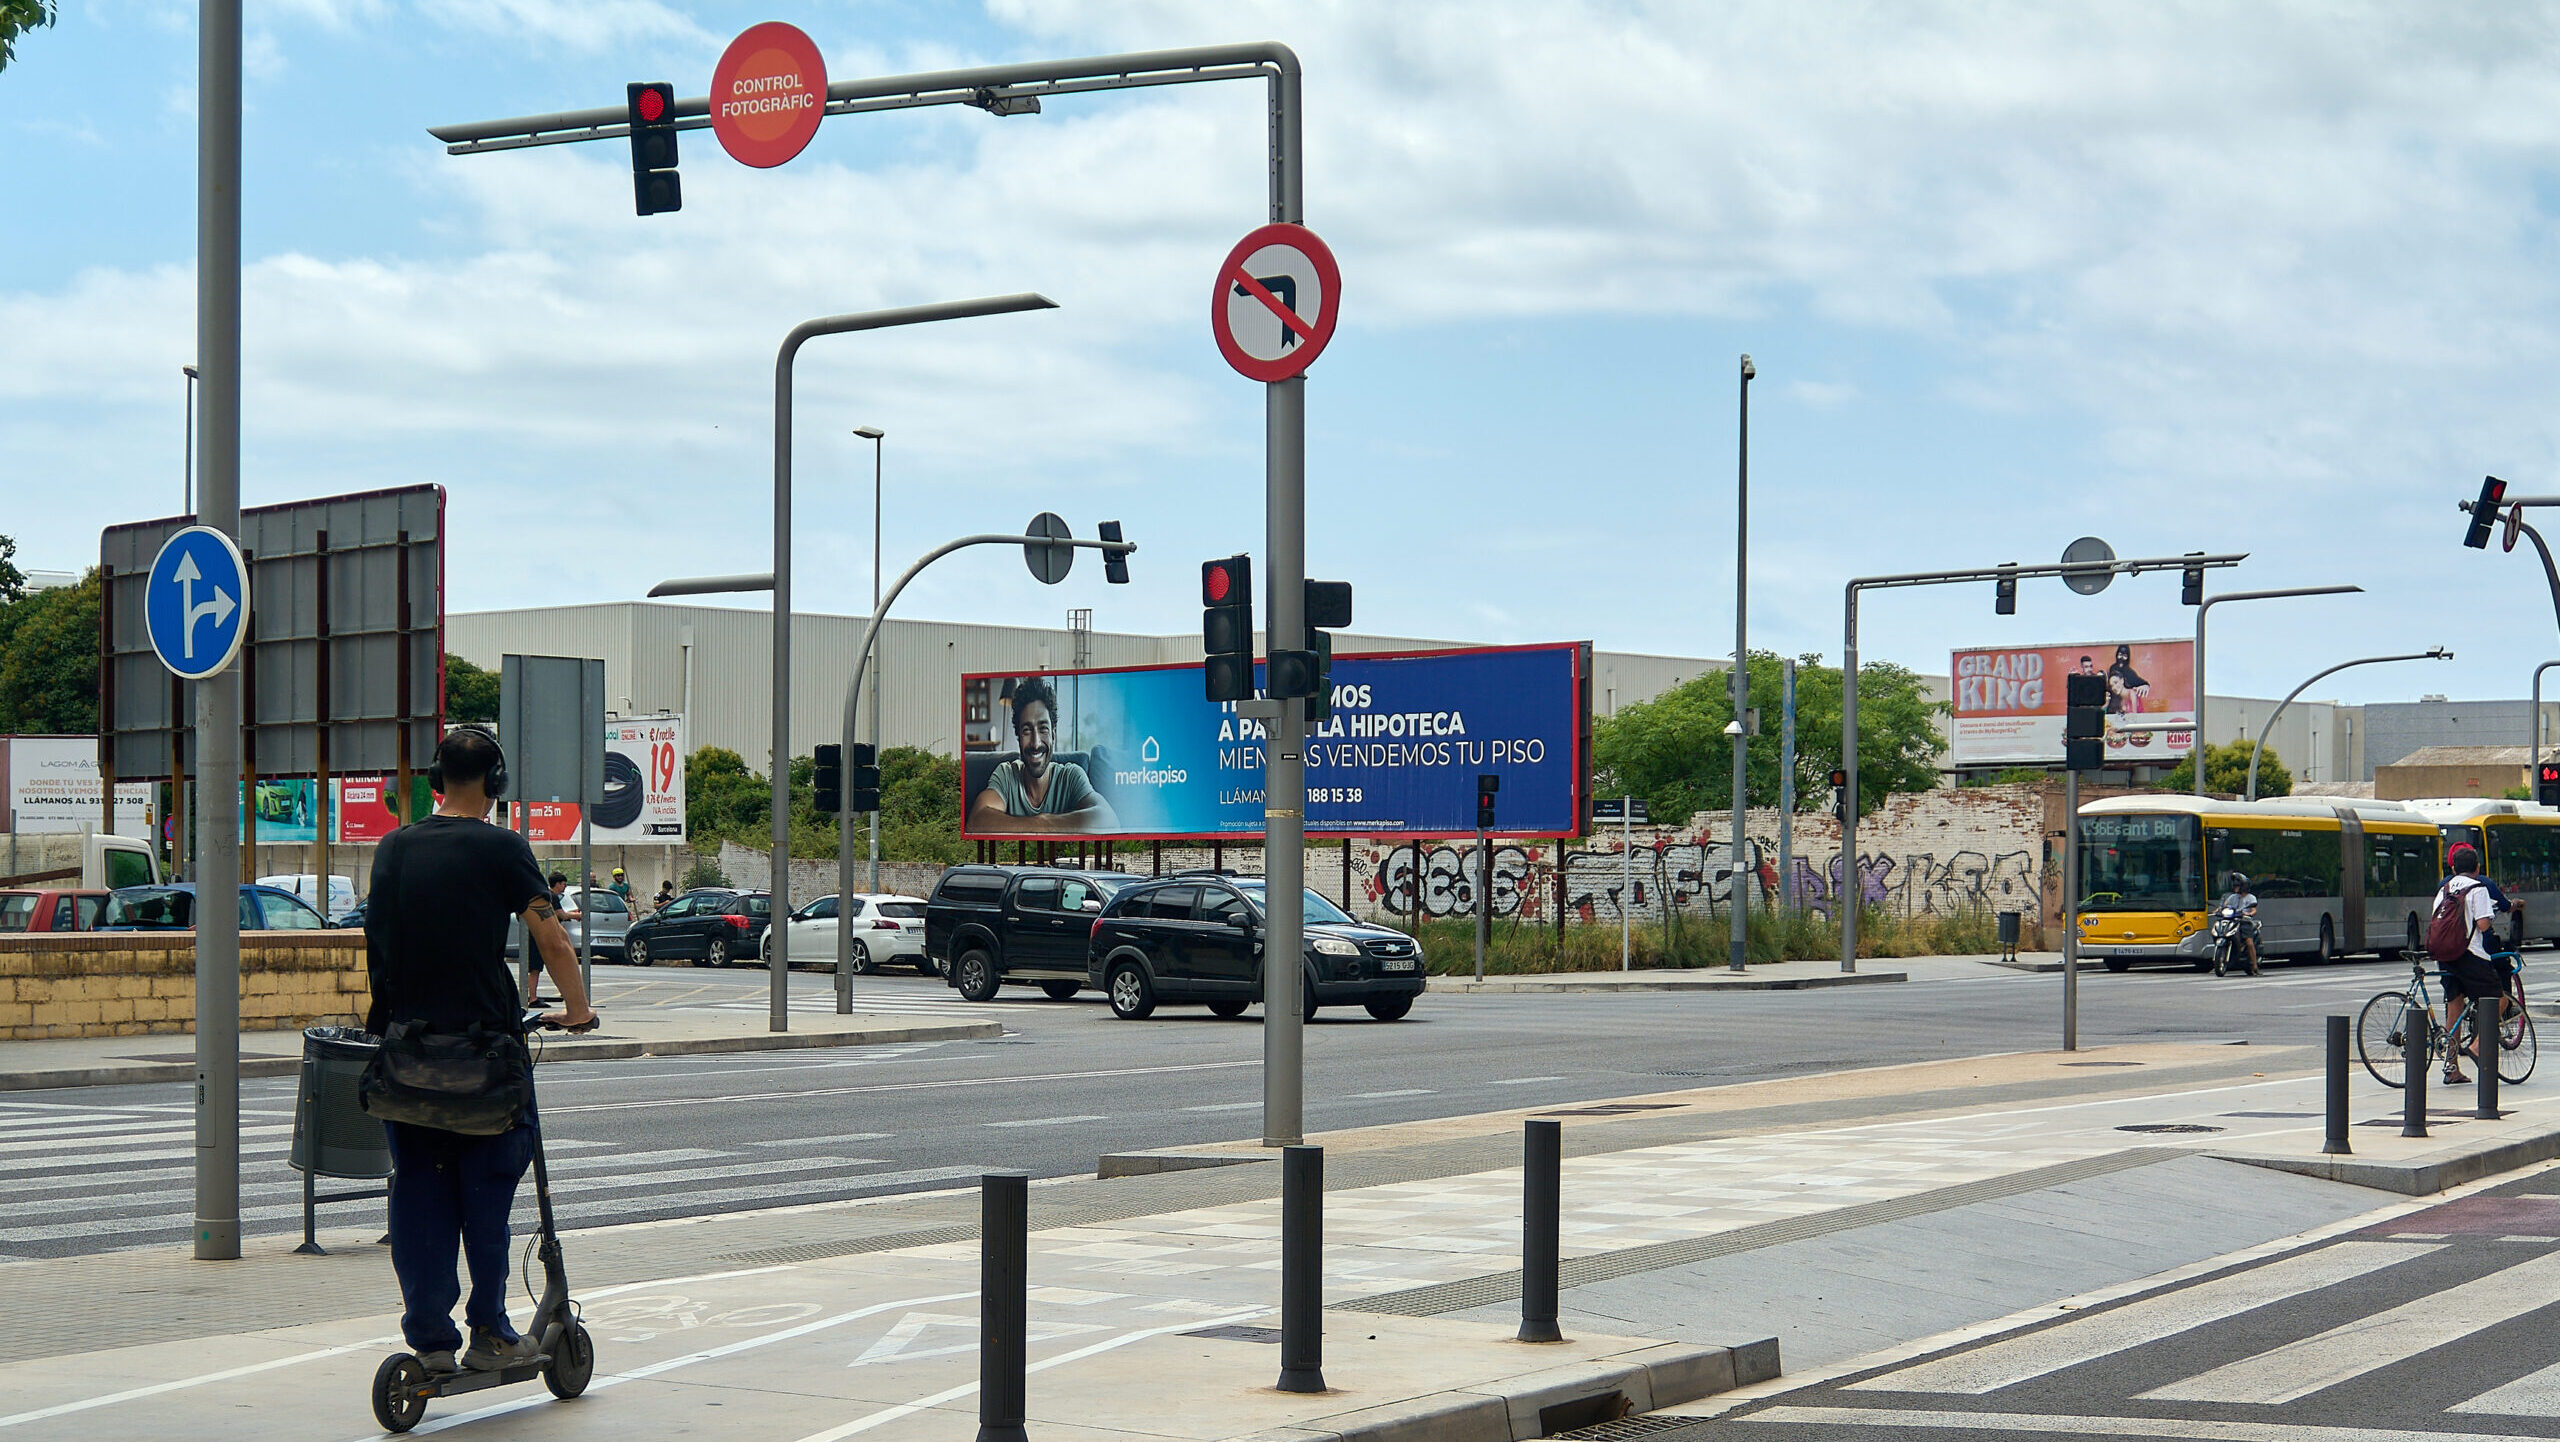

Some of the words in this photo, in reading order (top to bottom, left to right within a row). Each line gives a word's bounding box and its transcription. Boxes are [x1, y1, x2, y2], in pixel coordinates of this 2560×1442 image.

[733, 74, 803, 95] CONTROL
[722, 92, 814, 118] FOTOGRÀFIC
[1959, 653, 2044, 681] GRAND
[1958, 677, 2044, 711] KING
[1218, 719, 1234, 742] A
[1317, 714, 1345, 738] LA
[1351, 711, 1466, 738] HIPOTECA
[2167, 733, 2192, 744] KING
[1219, 744, 1321, 770] MIENS
[1326, 742, 1451, 768] VENDEMOS
[1455, 740, 1484, 766] TU
[1491, 738, 1546, 765] PISO
[651, 742, 675, 794] 19
[1115, 764, 1187, 788] merkapiso
[18, 787, 66, 795] NOSOTROS
[67, 787, 99, 795] VEMOS
[24, 795, 73, 805] LLÁMANOS
[127, 797, 144, 805] 508
[1220, 786, 1267, 805] LLÁMAN
[1307, 788, 1329, 803] 188
[1331, 788, 1344, 803] 15
[1346, 788, 1363, 803] 38
[544, 805, 553, 817] 25
[1353, 820, 1405, 828] www.merkapiso.com
[2154, 819, 2177, 837] Boi
